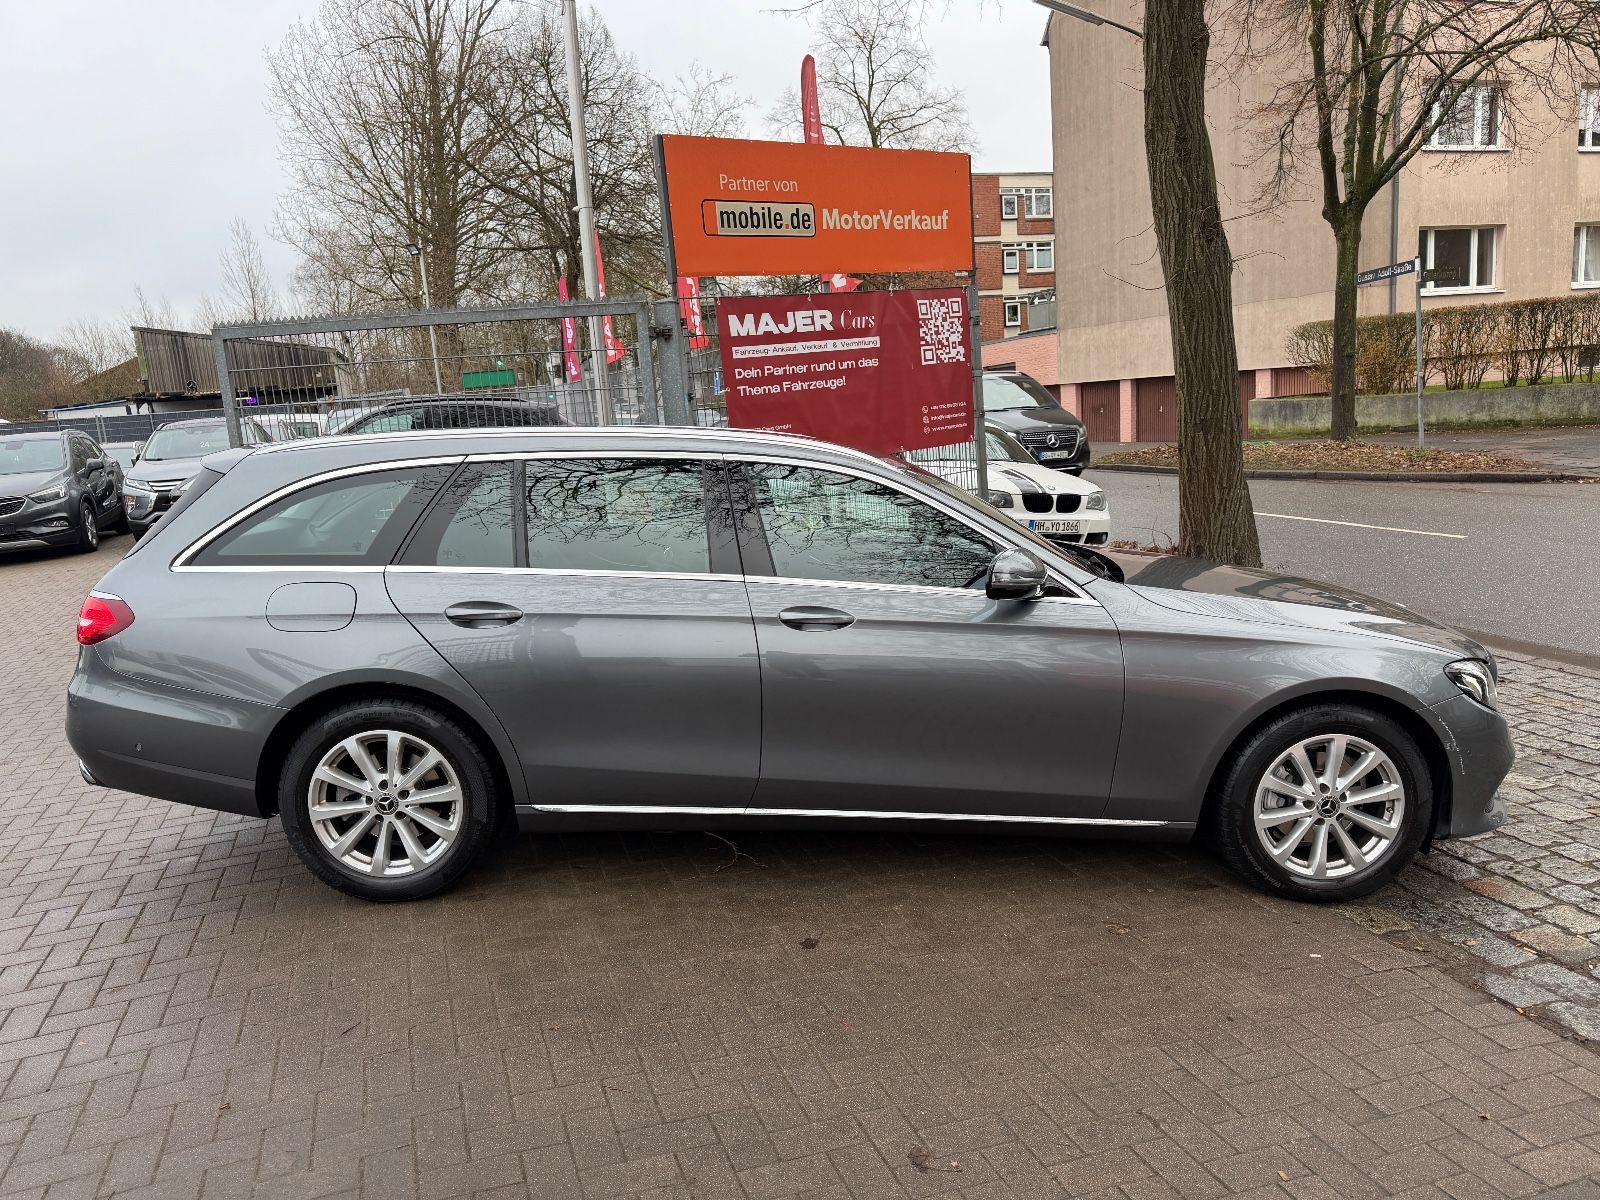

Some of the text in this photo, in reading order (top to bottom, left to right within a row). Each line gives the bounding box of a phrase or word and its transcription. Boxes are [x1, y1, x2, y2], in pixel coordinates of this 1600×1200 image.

[719, 174, 798, 192] Partner von
[719, 206, 949, 230] mobile.de MotorVerkauf
[728, 309, 875, 337] MAJER Cars
[801, 342, 828, 351] Verkauf
[832, 341, 838, 349] &
[840, 338, 878, 349] Vermittlung
[735, 357, 879, 380] Dein Partner rund um das
[737, 375, 847, 397] Thema Fahrzeuge!
[1061, 522, 1079, 531] 1866
